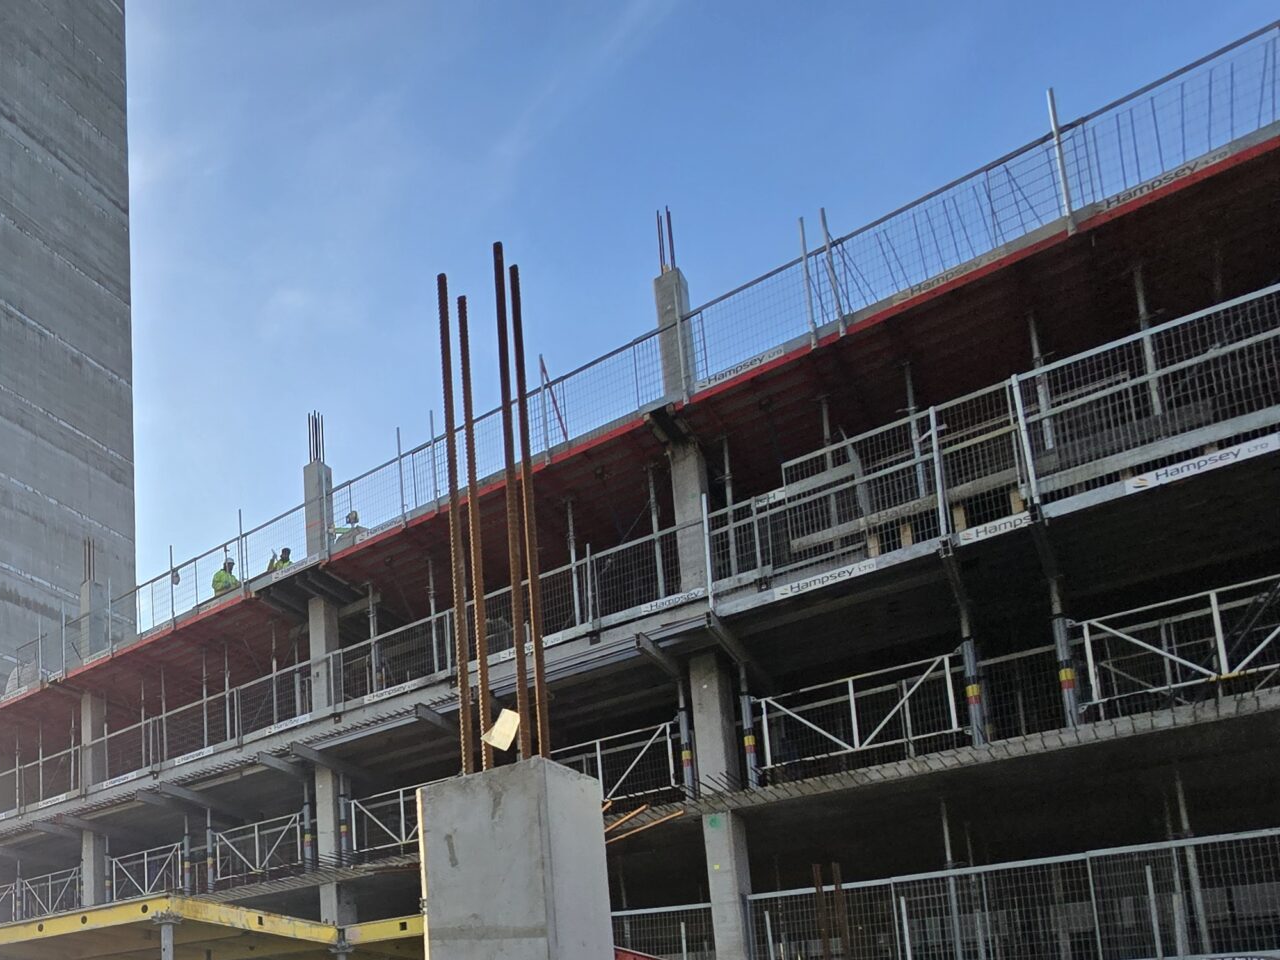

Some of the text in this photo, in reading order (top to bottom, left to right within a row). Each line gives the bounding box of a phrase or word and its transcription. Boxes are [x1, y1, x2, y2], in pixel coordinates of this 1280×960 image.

[1104, 161, 1198, 209] Hampsey
[708, 354, 765, 385] Hampsey
[1155, 442, 1269, 481] Hampsey LTD
[789, 567, 855, 593] Hampsey
[650, 590, 700, 611] Hampsey
